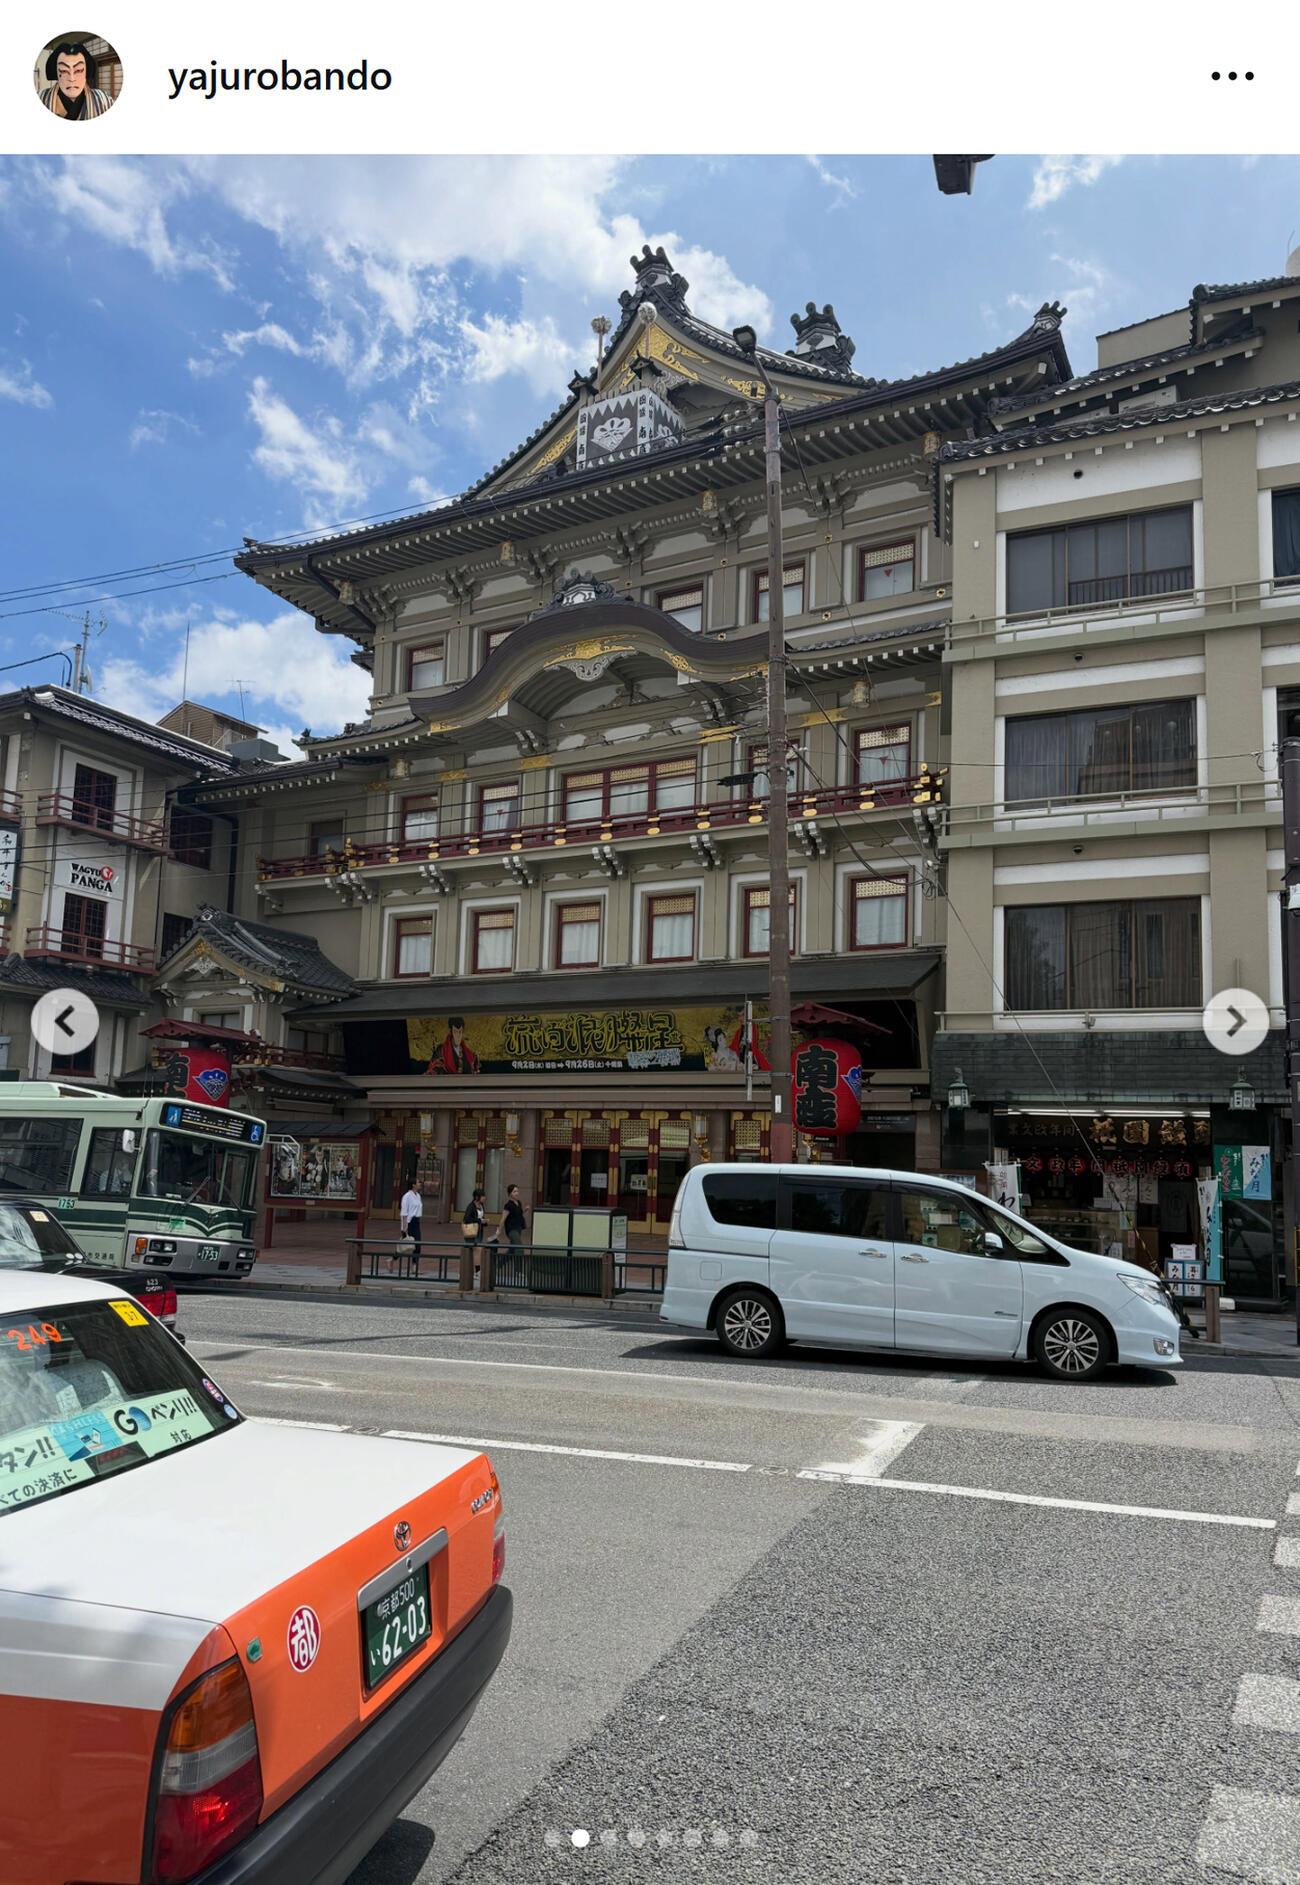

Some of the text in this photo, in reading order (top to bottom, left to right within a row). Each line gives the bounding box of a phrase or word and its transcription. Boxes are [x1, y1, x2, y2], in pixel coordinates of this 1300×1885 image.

[71, 863, 101, 877] WAGYU
[70, 873, 113, 893] PANGA
[796, 1044, 838, 1128] 南座
[58, 1198, 75, 1209] 1753
[8, 1323, 62, 1351] 249
[51, 1412, 104, 1434] CASHLESS
[290, 1608, 319, 1669] 都
